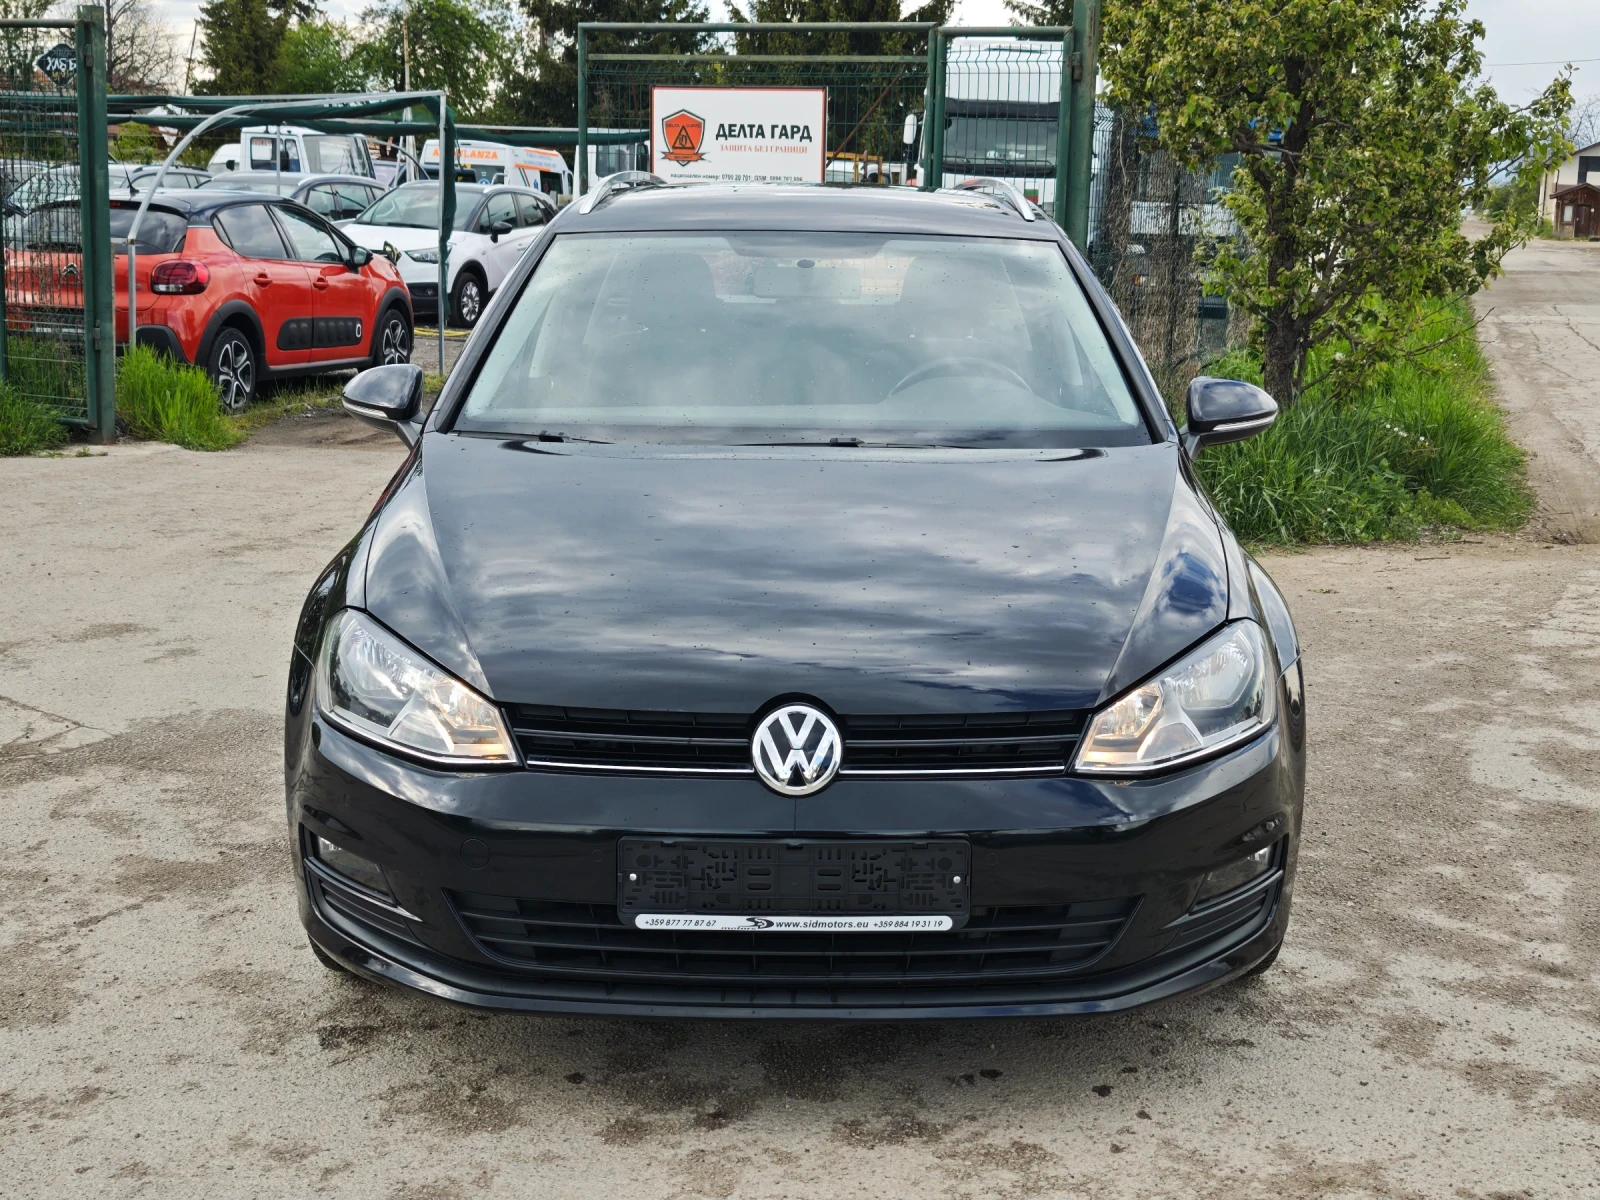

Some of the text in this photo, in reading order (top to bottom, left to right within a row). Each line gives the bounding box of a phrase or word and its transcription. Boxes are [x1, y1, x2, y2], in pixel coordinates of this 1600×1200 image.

[715, 123, 813, 143] ДЕЛТА ГАРД
[644, 918, 717, 927] +359 877 77 87 67
[775, 919, 869, 929] www.sidmotors.eu
[873, 919, 944, 928] +359 884 19 31 19
